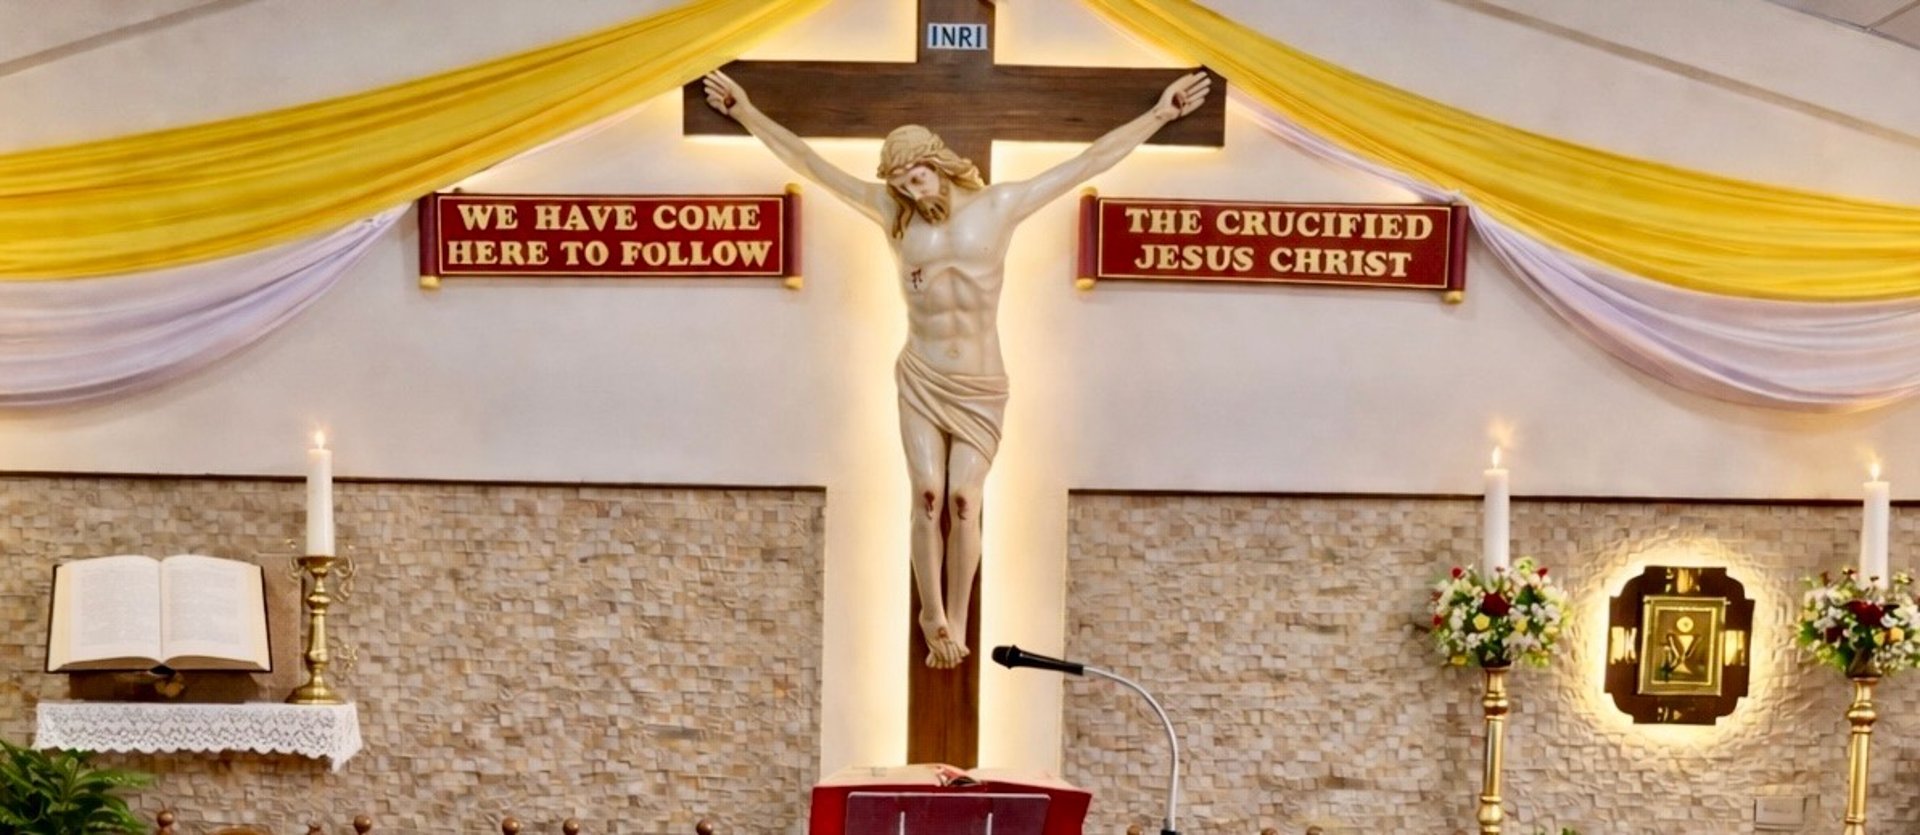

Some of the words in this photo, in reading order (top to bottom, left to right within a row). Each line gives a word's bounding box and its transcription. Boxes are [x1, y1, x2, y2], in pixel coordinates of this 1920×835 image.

[932, 25, 981, 48] INRI
[457, 204, 518, 230] WE
[535, 204, 637, 231] HAVE
[652, 204, 761, 231] COME
[1125, 207, 1202, 235] THE
[1215, 209, 1433, 240] CRUCIFIED
[447, 240, 549, 265] HERE
[560, 240, 609, 266] TO
[620, 240, 773, 267] FOLLOW
[1134, 244, 1254, 271] JESUS
[1269, 248, 1412, 277] CHRIST
